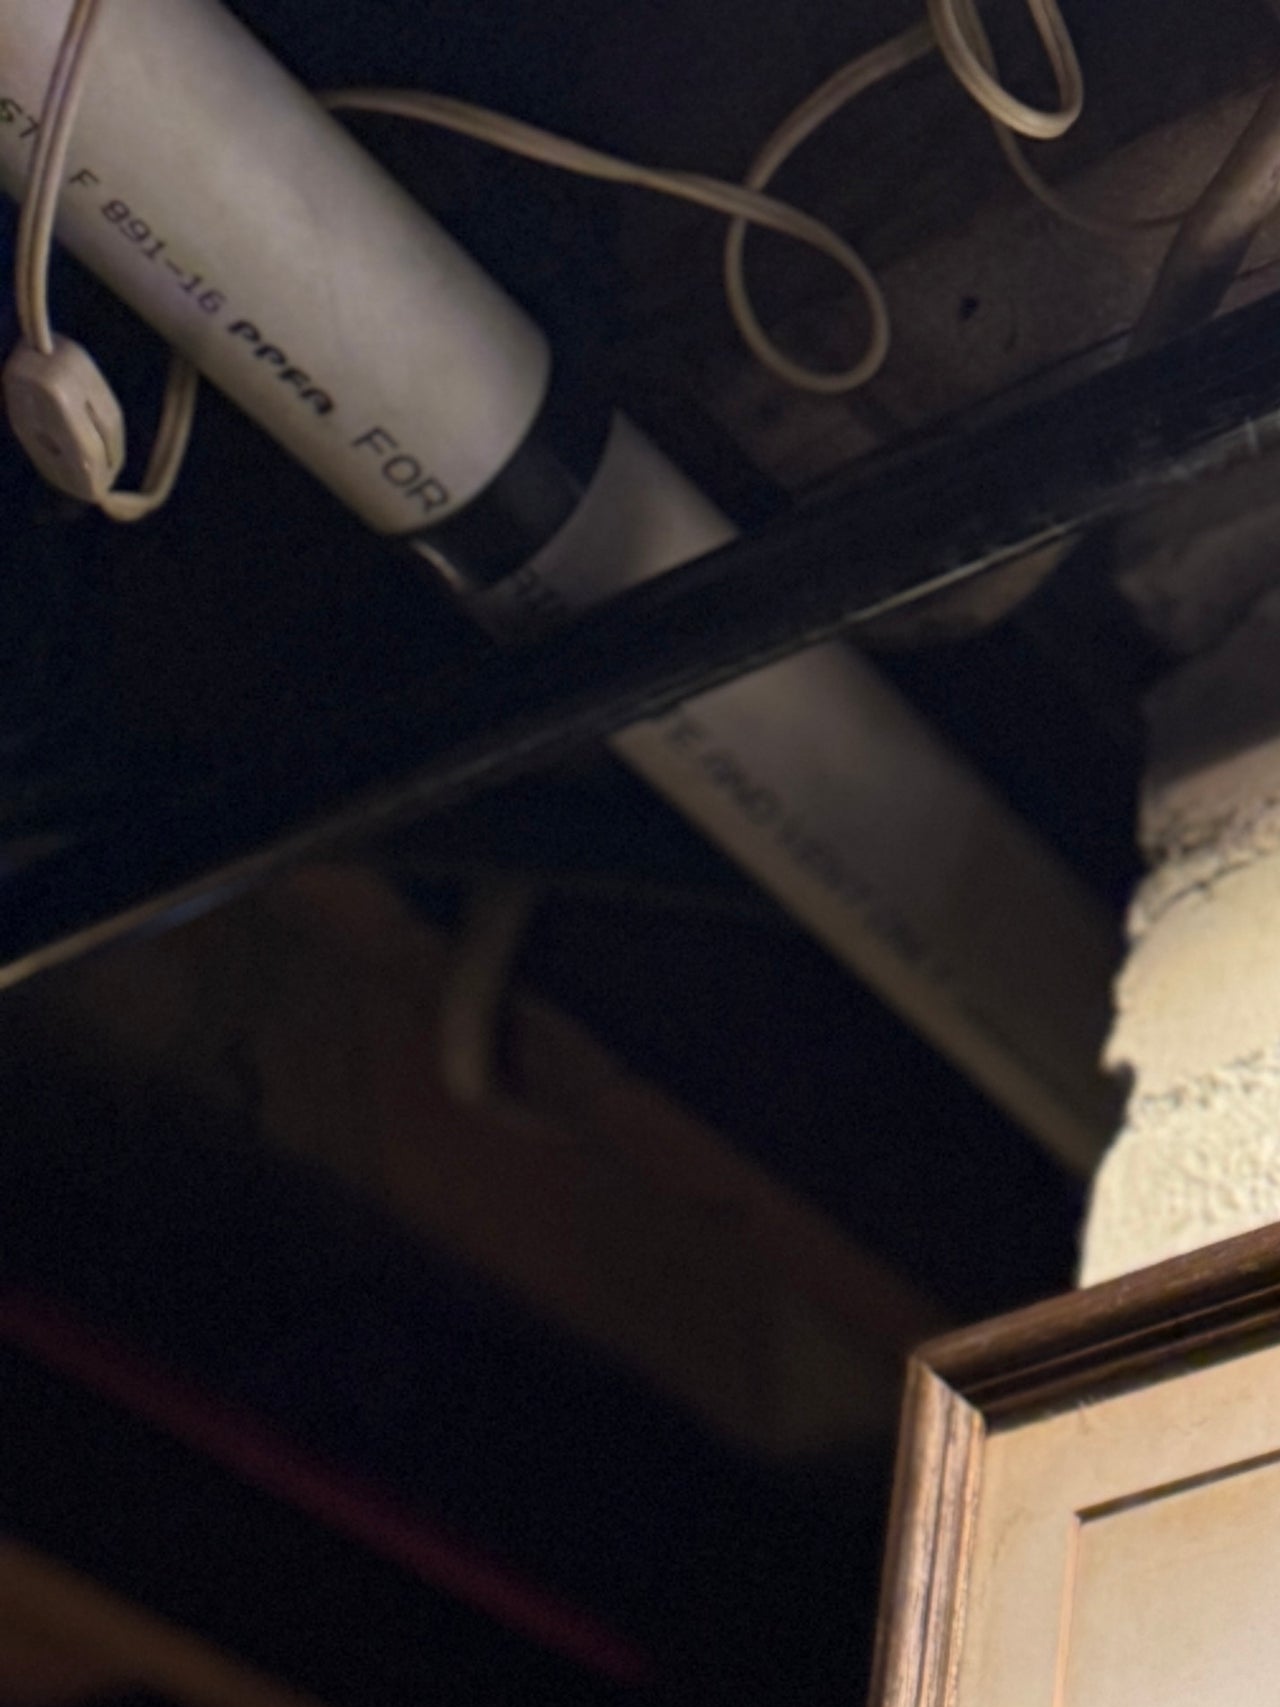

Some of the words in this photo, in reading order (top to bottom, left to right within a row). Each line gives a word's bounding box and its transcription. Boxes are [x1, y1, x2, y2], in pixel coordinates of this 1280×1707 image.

[68, 168, 101, 186] F
[100, 199, 228, 314] 891-16
[351, 425, 450, 514] FOR
